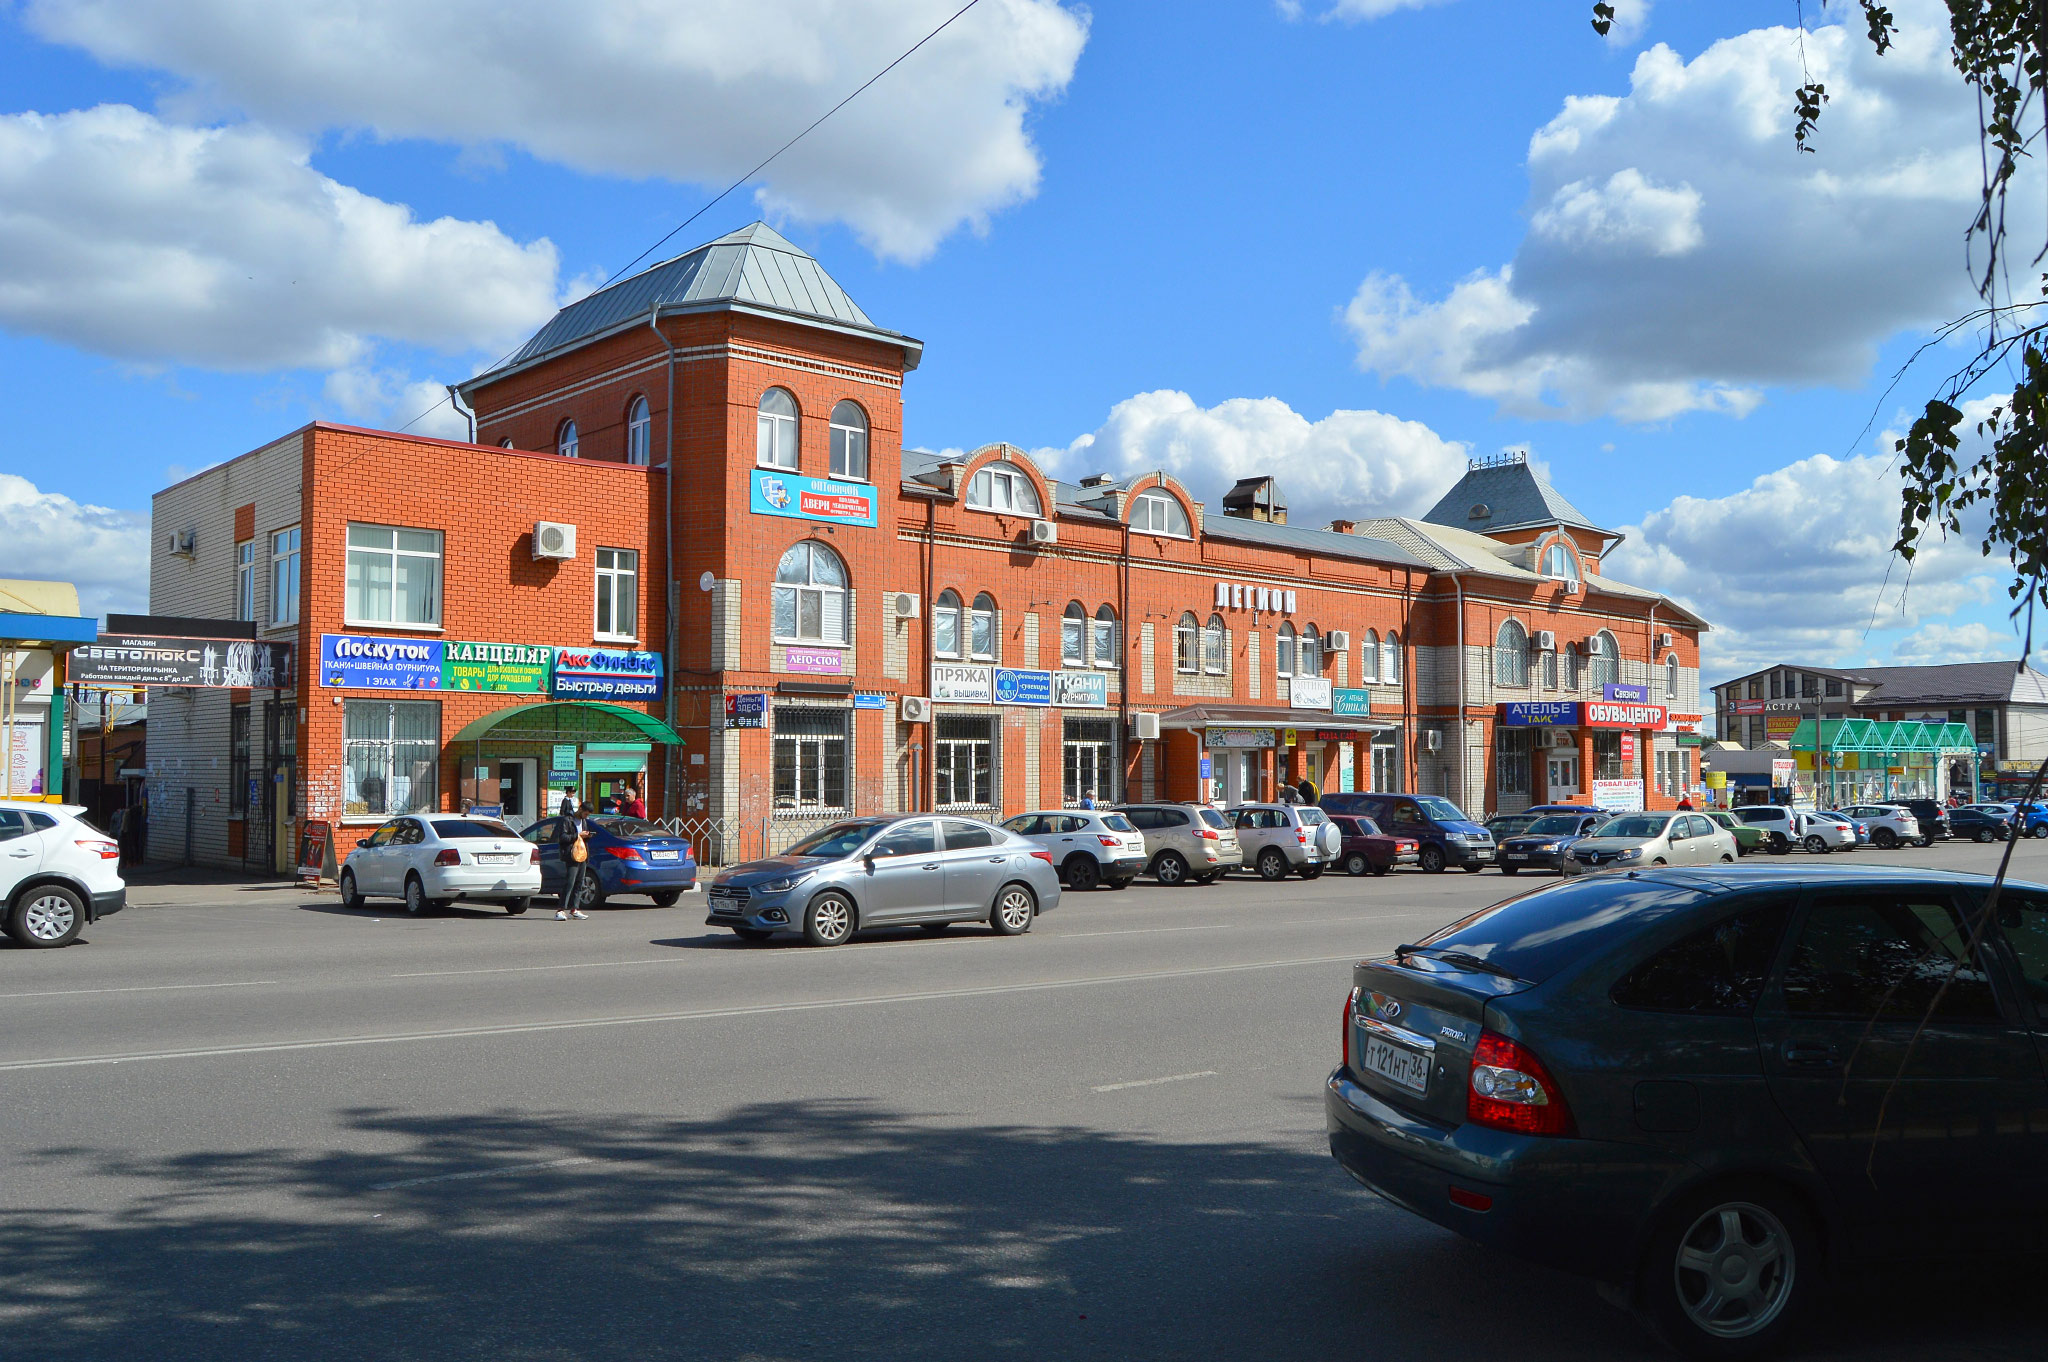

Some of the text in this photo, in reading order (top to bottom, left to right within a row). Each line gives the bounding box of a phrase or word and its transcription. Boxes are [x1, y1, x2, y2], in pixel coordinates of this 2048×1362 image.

[803, 498, 830, 511] ДВЕРИ
[1215, 582, 1296, 613] ЛЕГИОН
[122, 639, 157, 647] МАГАЗИН
[335, 637, 430, 661] Лоскуток
[446, 644, 550, 665] КАНЦЕЛЯР
[558, 649, 657, 670] Акс Финанс
[789, 654, 839, 666] ЛЕГО-СТОК
[97, 664, 178, 674] НА ТЕРИТОРИИ РЫНКА
[324, 661, 441, 673] ТКАНИ ШВЕЙНАЯ ФУРНИТУРА
[453, 666, 485, 677] ТОВАРЫ
[487, 665, 499, 674] ДЛЯ
[524, 667, 542, 675] ОФИСА
[80, 672, 113, 680] Работаем
[487, 673, 532, 683] ДЛЯ РУКОДЕЛИЯ
[934, 668, 987, 683] ПРЯЖА
[999, 672, 1016, 683] ФОТО
[366, 677, 397, 686] 1 ЭТАЖ
[556, 677, 657, 695] Быстрые деньги
[1056, 673, 1102, 691] ТКАНИ
[737, 694, 762, 704] Деньги
[954, 689, 988, 699] ВЫШИВКА
[1062, 692, 1099, 702] ФУРНИТУРА
[1614, 687, 1640, 700] Связной
[737, 704, 762, 712] ЗДЕСЬ
[1335, 694, 1368, 713] Стиль
[1512, 703, 1571, 714] АТЕЛЬЕ
[1729, 702, 1735, 710] 3
[1765, 702, 1801, 711] АСТРА
[1589, 703, 1662, 726] ОБУВЬЦЕНТР
[1440, 1026, 1467, 1042] PRIORA
[1411, 1054, 1423, 1078] 36
[1408, 1075, 1418, 1086] RUS
